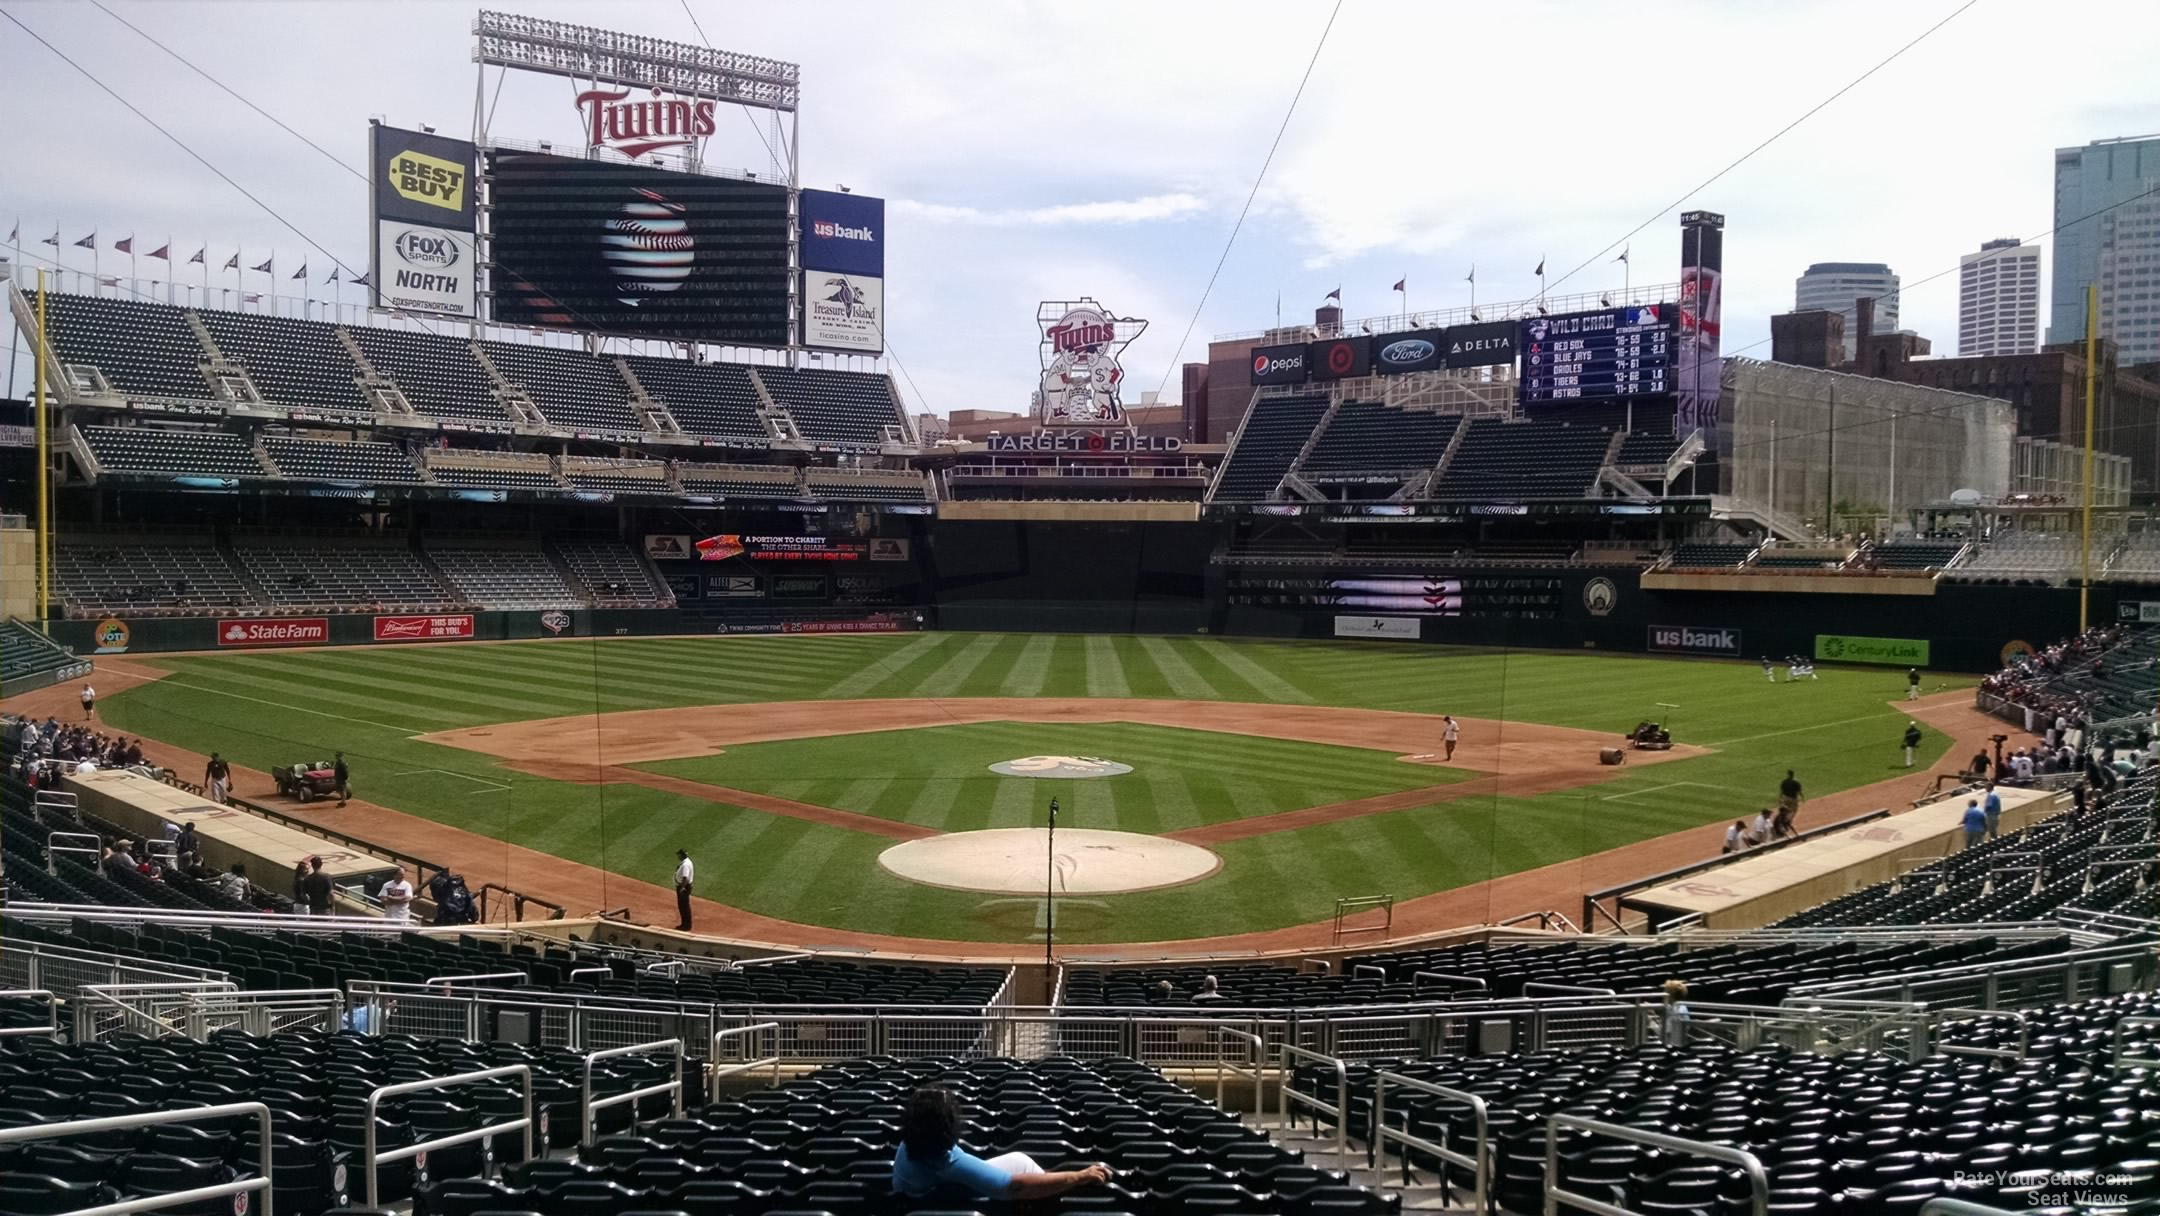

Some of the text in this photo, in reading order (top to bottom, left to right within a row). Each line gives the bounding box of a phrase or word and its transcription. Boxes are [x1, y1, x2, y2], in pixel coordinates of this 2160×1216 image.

[576, 86, 716, 150] Twins
[399, 158, 462, 187] BEST
[401, 175, 456, 200] BUY
[409, 236, 445, 256] FOX
[409, 252, 447, 263] SPORTS
[396, 270, 458, 293] NORTH
[393, 297, 464, 312] FOXSPORTSNORTH.COM
[813, 302, 875, 319] Treasure Island
[1550, 314, 1614, 334] WILD CARD
[820, 332, 869, 342] ticasino.com
[1047, 320, 1115, 352] Twins
[1465, 338, 1510, 352] DELTA
[1554, 342, 1568, 351] RED
[1570, 340, 1584, 349] SOX
[1391, 343, 1424, 362] Ford
[1554, 353, 1572, 363] BLUE
[1574, 351, 1592, 361] JAYS
[1271, 355, 1302, 372] pepsi
[1554, 364, 1582, 375] ORIOLES
[1554, 376, 1579, 386] TIGERS
[1553, 388, 1581, 398] ASTROS
[1, 434, 32, 442] LUBHOUSE
[988, 436, 1182, 450] TARGET FIELD
[776, 580, 824, 591] SUBWAY
[431, 618, 468, 627] THIS BUD'S
[555, 616, 568, 626] 29
[386, 624, 422, 632] Budweiser
[431, 627, 444, 635] FOR
[100, 632, 126, 641] VOTE
[1848, 643, 1920, 657] CenturyLink
